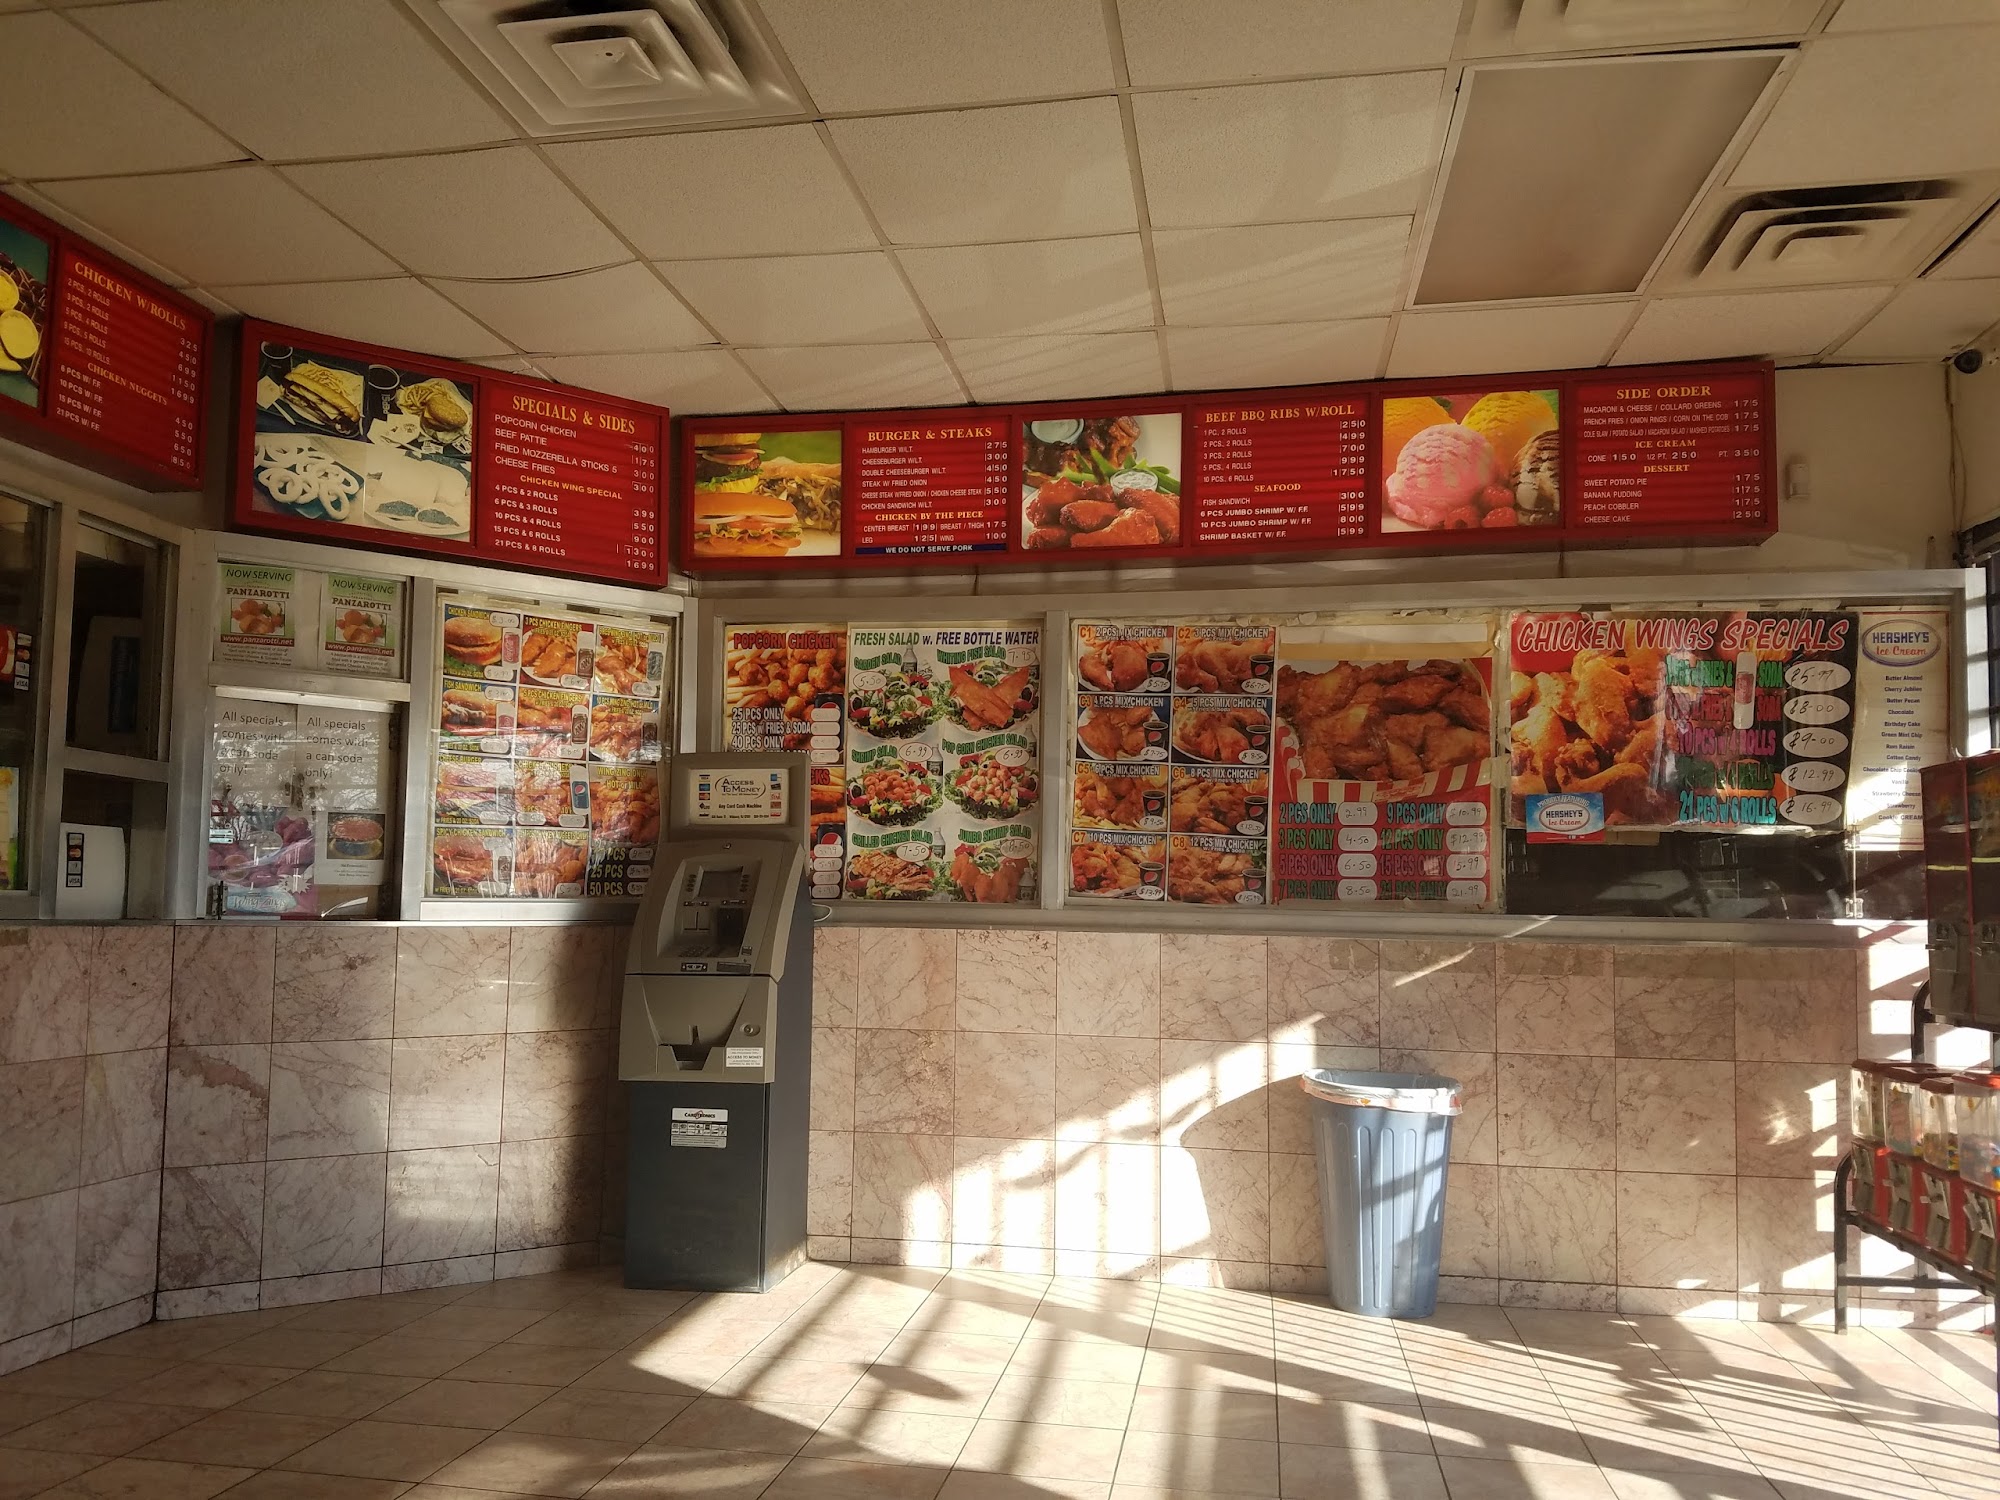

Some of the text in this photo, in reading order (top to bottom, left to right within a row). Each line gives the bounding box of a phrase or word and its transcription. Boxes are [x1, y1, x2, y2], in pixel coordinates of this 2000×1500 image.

[75, 262, 186, 331] CHICKEN W/ROLLS
[87, 362, 167, 405] CHICKEN NUGGETS
[1617, 386, 1711, 400] SIDE ORDER
[512, 395, 635, 434] SPECIALS & SIDES
[1206, 405, 1355, 423] BEEF BBQ RIBS W/ROLL
[1584, 405, 1617, 414] MACARONI
[1627, 404, 1652, 412] CHEESE
[495, 415, 576, 438] POPCORN CHICKEN
[496, 428, 547, 445] BEEF PATTIE
[868, 428, 992, 441] BURGER & STEAKS
[495, 443, 520, 453] FRIED
[523, 448, 578, 466] MOZZERELLA
[581, 460, 609, 472] STICKS
[496, 456, 555, 474] CHEESE FRIES
[1644, 464, 1690, 473] DESSERT
[520, 475, 622, 500] CHICKEN WING SPECIAL
[1254, 483, 1301, 492] SEAFOOD
[1584, 479, 1607, 487] SWEET
[1610, 478, 1635, 486] POTATO
[502, 485, 518, 494] PCS
[533, 491, 558, 501] ROLLS
[1584, 490, 1642, 499] BANANA PUDDING
[1255, 507, 1284, 515] SHRIMP
[1608, 502, 1639, 510] COBBLER
[1613, 515, 1631, 523] CAKE
[1200, 533, 1229, 541] SHRIMP
[226, 569, 292, 582] NOW SERVING
[333, 579, 394, 594] NOW SERVING
[226, 588, 290, 599] PANZAROTTI
[332, 598, 391, 611] PANZAROTTI
[854, 631, 1039, 645] FRESH SALAD w. FREE BOTTLE WATER
[1080, 627, 1167, 638] C1 PCS MIX CHICKEN
[1178, 628, 1268, 639] C2 PCS MIX CHICKEN
[1517, 617, 1849, 652] CHICKEN WINGS SPECIALS
[1872, 632, 1930, 644] HERSHEY'S
[223, 636, 293, 646] www.panzarotti.net
[734, 633, 838, 649] POPCORN CHICKEN
[937, 646, 1006, 664] WHITING FISH SALAD
[1876, 646, 1926, 656] Ice Cream
[854, 652, 902, 670] GARDEN SALAD
[732, 708, 785, 720] 25 PCS ONLY
[307, 717, 366, 731] All specials
[315, 752, 334, 762] can
[337, 754, 363, 764] soda
[852, 745, 897, 763] SHRIMP SALAD
[1173, 768, 1258, 779] C6 8 PCS MIX CHICKEN
[722, 778, 754, 786] ACCESS
[1279, 803, 1336, 824] 2 PCS ONLY
[1546, 810, 1583, 818] HERSHEY'S
[852, 829, 933, 847] GRILLED CHICKEN SALAD
[1173, 836, 1185, 847] C8
[1279, 828, 1334, 850] 3 PCS ONLY
[590, 864, 623, 879] 25 PCS
[589, 882, 623, 896] 50 PCS
